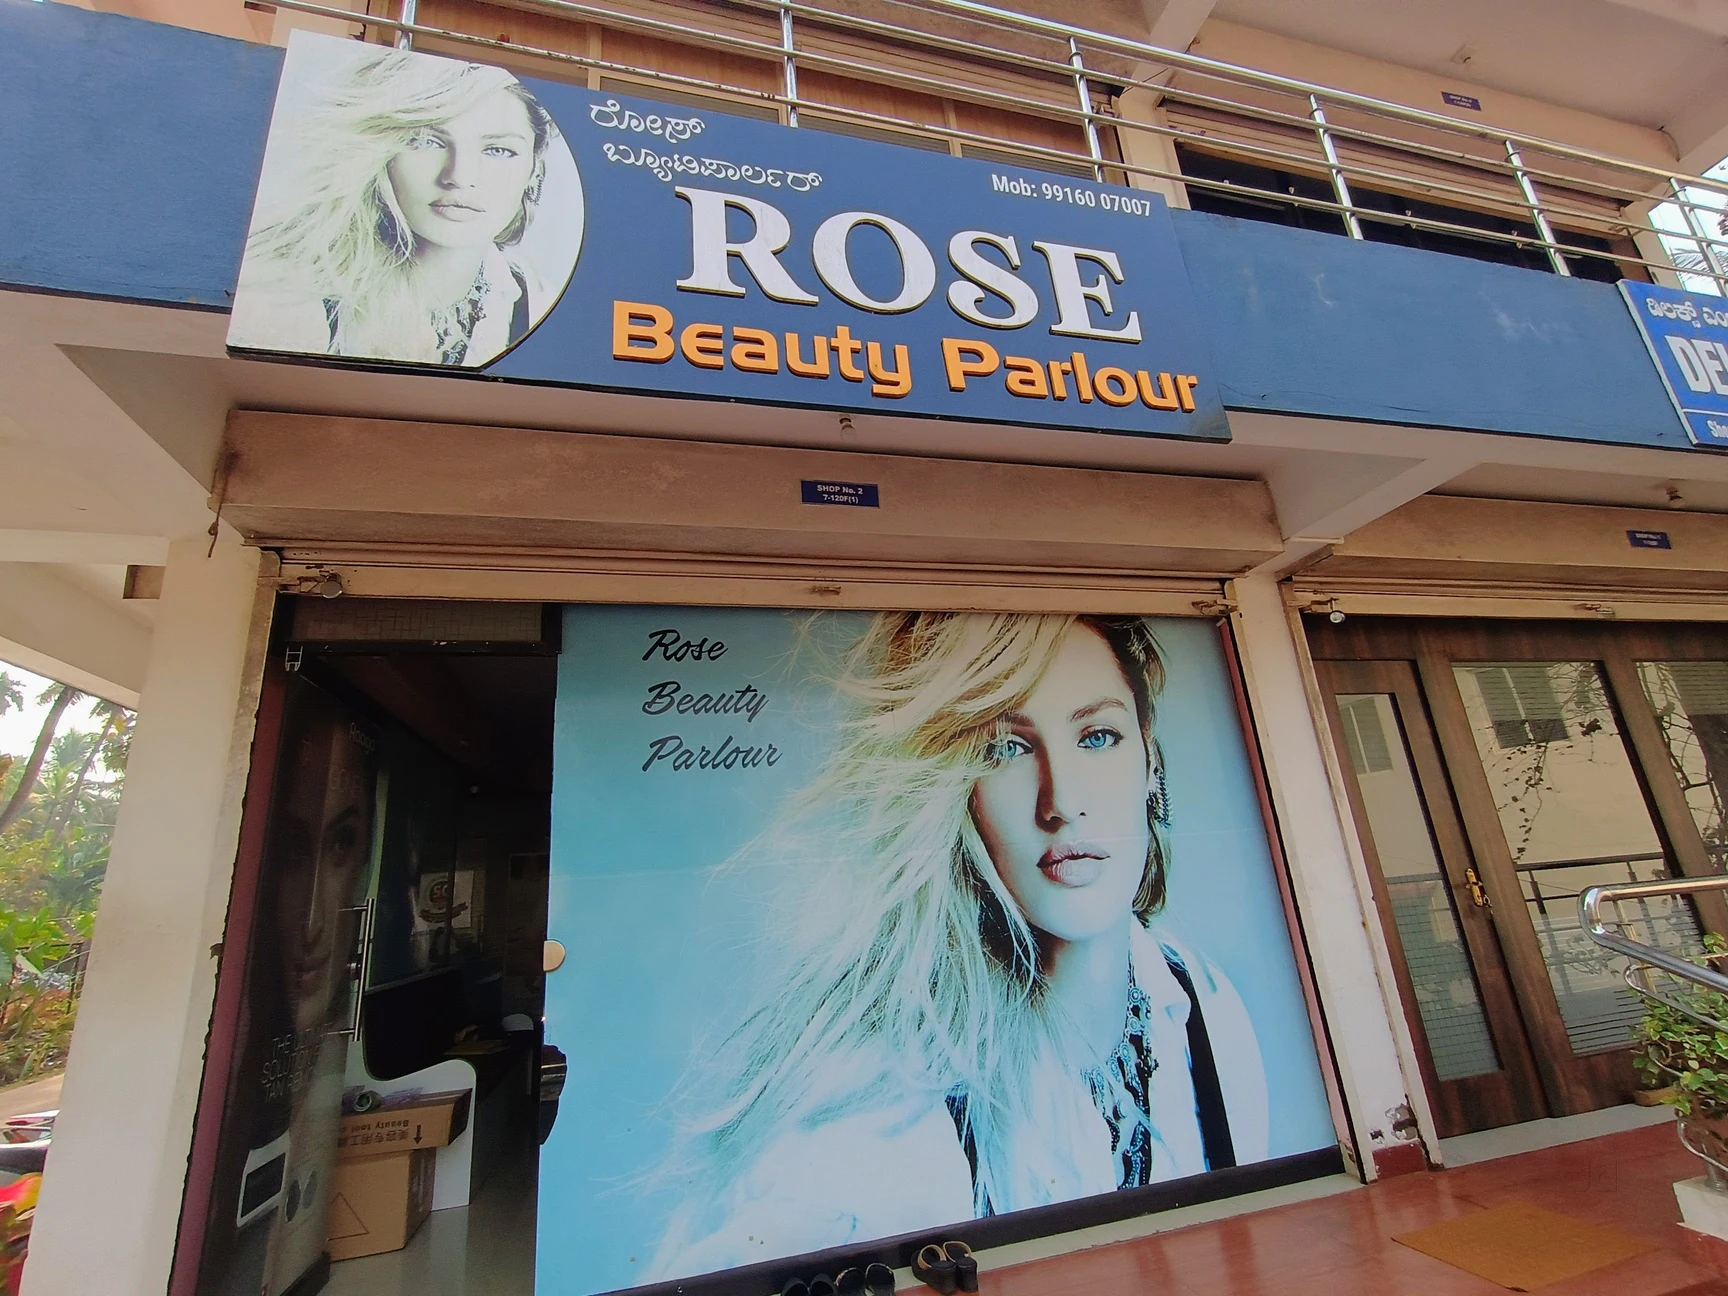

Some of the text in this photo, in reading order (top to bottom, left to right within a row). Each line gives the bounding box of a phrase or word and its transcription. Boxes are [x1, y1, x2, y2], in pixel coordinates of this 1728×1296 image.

[589, 99, 706, 144] ರೋಸ್
[991, 173, 1151, 217] Mob: 99160 07007
[675, 184, 1143, 344] ROSE
[611, 298, 1198, 412] Beauty Parlour
[817, 485, 840, 493] SHOP
[822, 494, 859, 503] 7-120F(1)
[641, 628, 729, 662] Rose
[641, 680, 769, 724] Beauty
[641, 734, 784, 773] Parlour
[375, 1119, 410, 1130] Beauty
